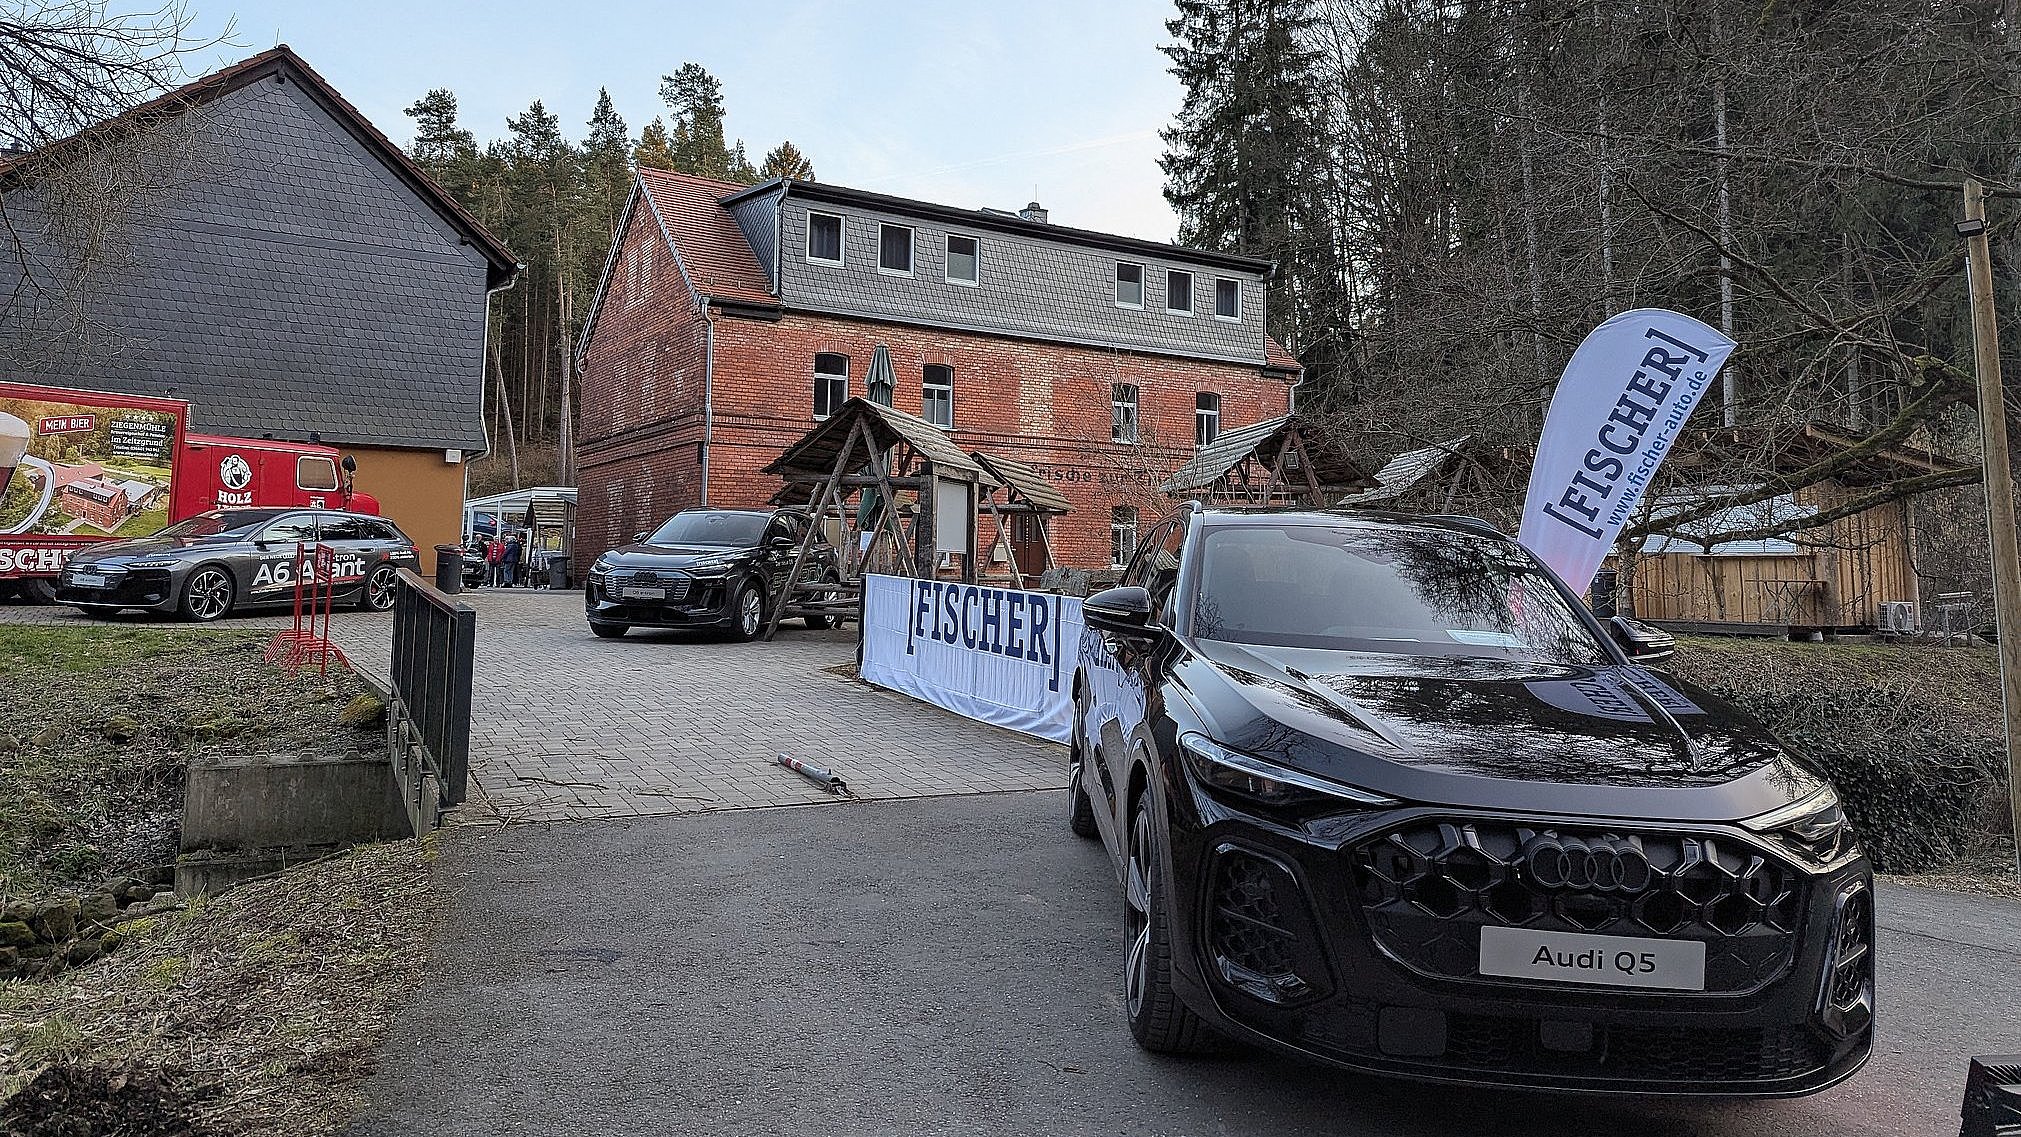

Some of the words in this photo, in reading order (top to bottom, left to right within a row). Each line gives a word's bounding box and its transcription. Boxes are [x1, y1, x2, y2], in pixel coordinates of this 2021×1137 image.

[45, 419, 67, 431] MEIN
[70, 418, 90, 429] BIER
[110, 420, 167, 433] ZIEGENMÜHLE
[1543, 327, 1709, 541] [FISCHER]
[1606, 369, 1708, 527] www.fischer-auto.de
[217, 489, 253, 505] HOLZ
[251, 561, 291, 587] A6
[906, 578, 1062, 693] [FISCHER]
[1531, 945, 1604, 970] Audi
[1614, 951, 1656, 976] Q5
